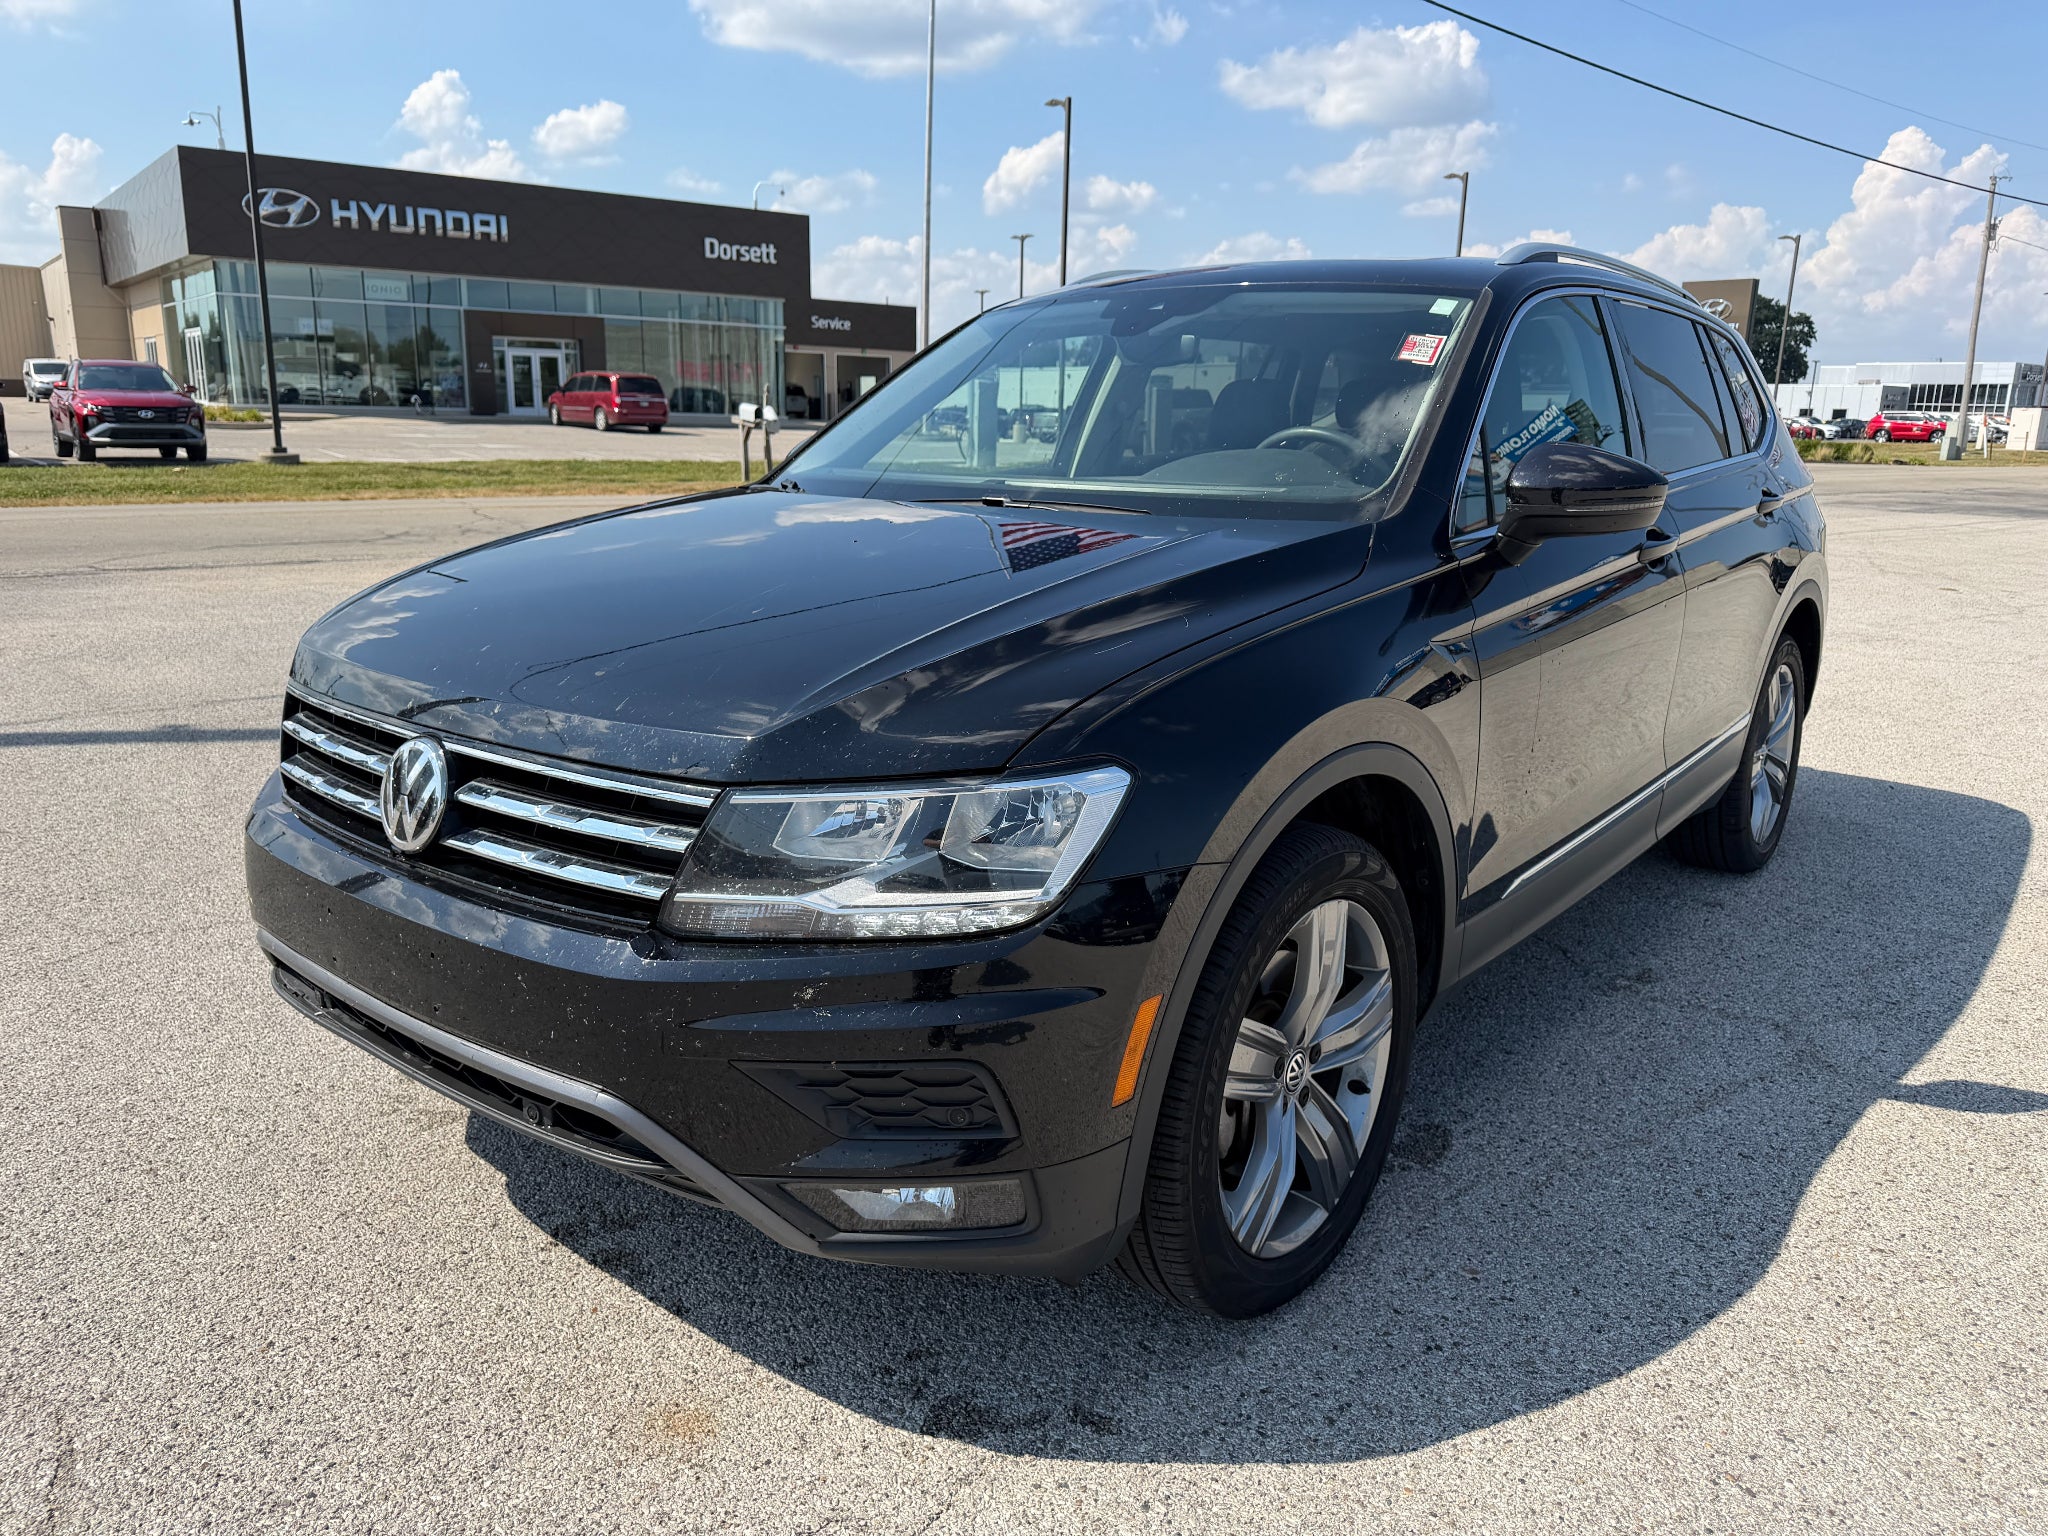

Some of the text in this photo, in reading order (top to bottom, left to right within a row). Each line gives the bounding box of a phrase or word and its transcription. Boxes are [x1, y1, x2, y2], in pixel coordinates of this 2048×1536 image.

[330, 199, 509, 242] HYUNDAI
[704, 236, 778, 264] Dorsett
[811, 315, 851, 330] Service
